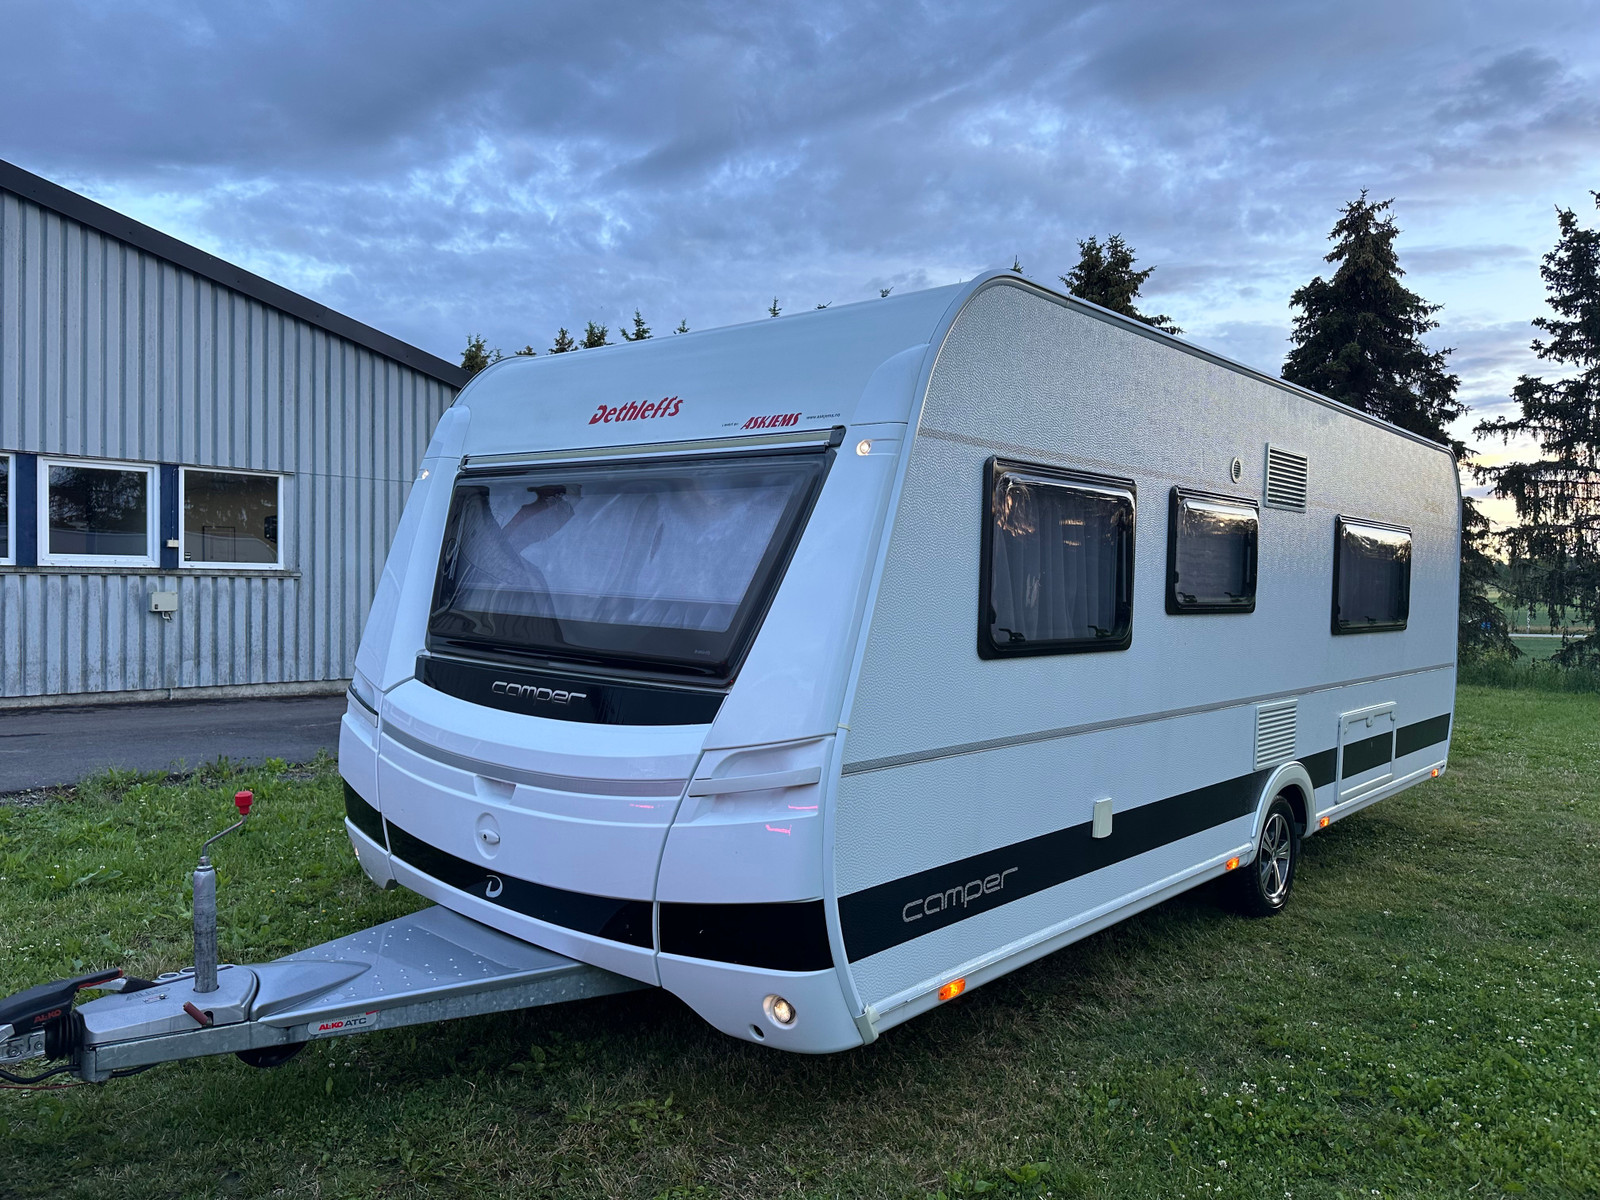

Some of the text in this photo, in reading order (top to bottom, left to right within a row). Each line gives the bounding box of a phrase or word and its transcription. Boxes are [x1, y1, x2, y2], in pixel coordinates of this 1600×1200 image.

[588, 396, 684, 425] Dethleffs
[740, 412, 802, 430] ASKJEMS
[491, 680, 587, 705] camper
[902, 866, 1019, 922] camper
[344, 1017, 367, 1027] ATC
